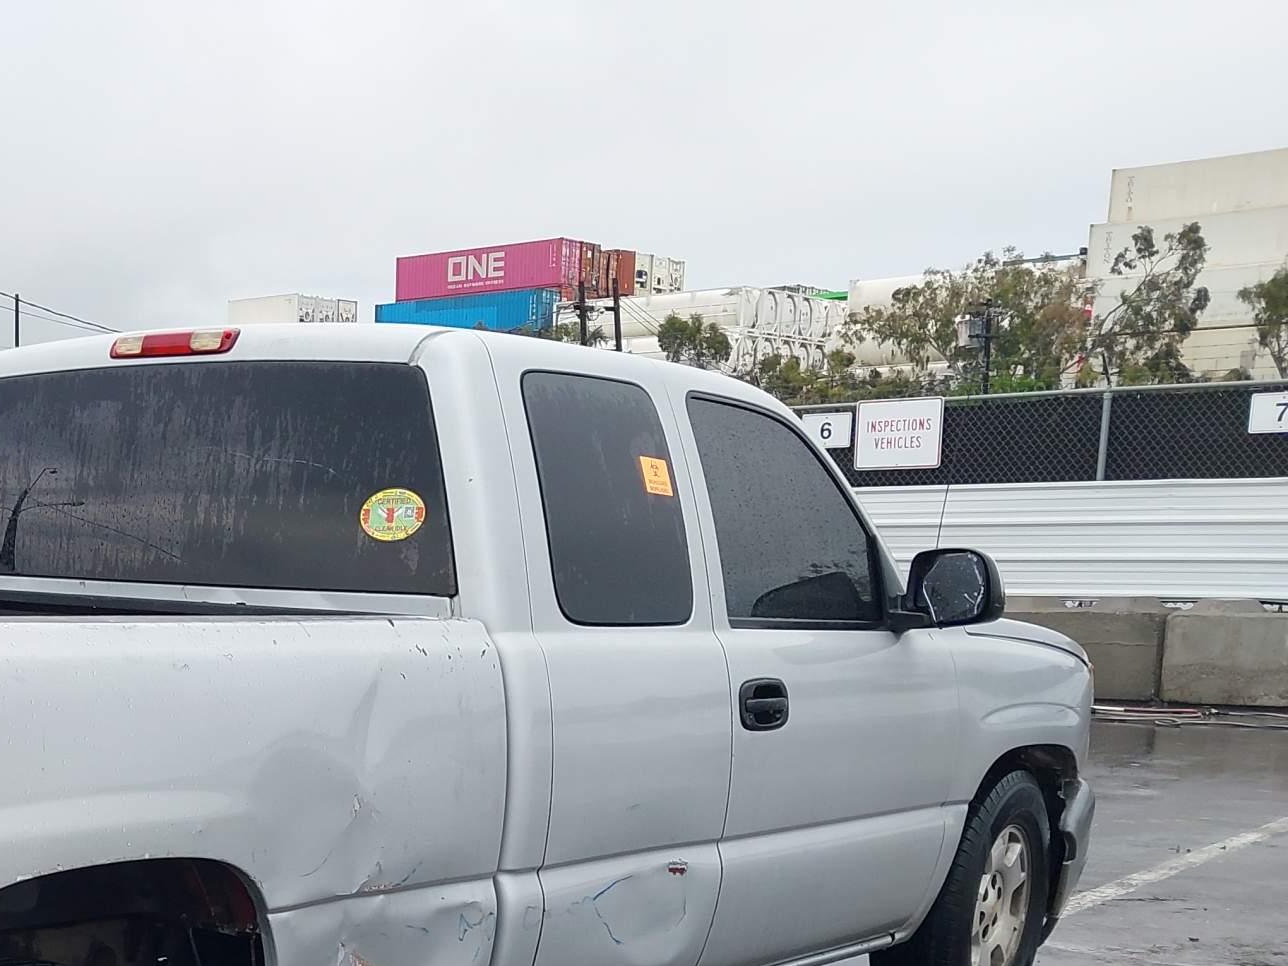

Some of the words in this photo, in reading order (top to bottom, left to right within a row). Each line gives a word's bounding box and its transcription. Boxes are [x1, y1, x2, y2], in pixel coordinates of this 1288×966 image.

[447, 251, 505, 282] ONE
[1275, 402, 1288, 422] 7
[820, 422, 832, 440] 6
[866, 418, 932, 433] INSPECTIONS
[874, 435, 922, 450] VEHICLES
